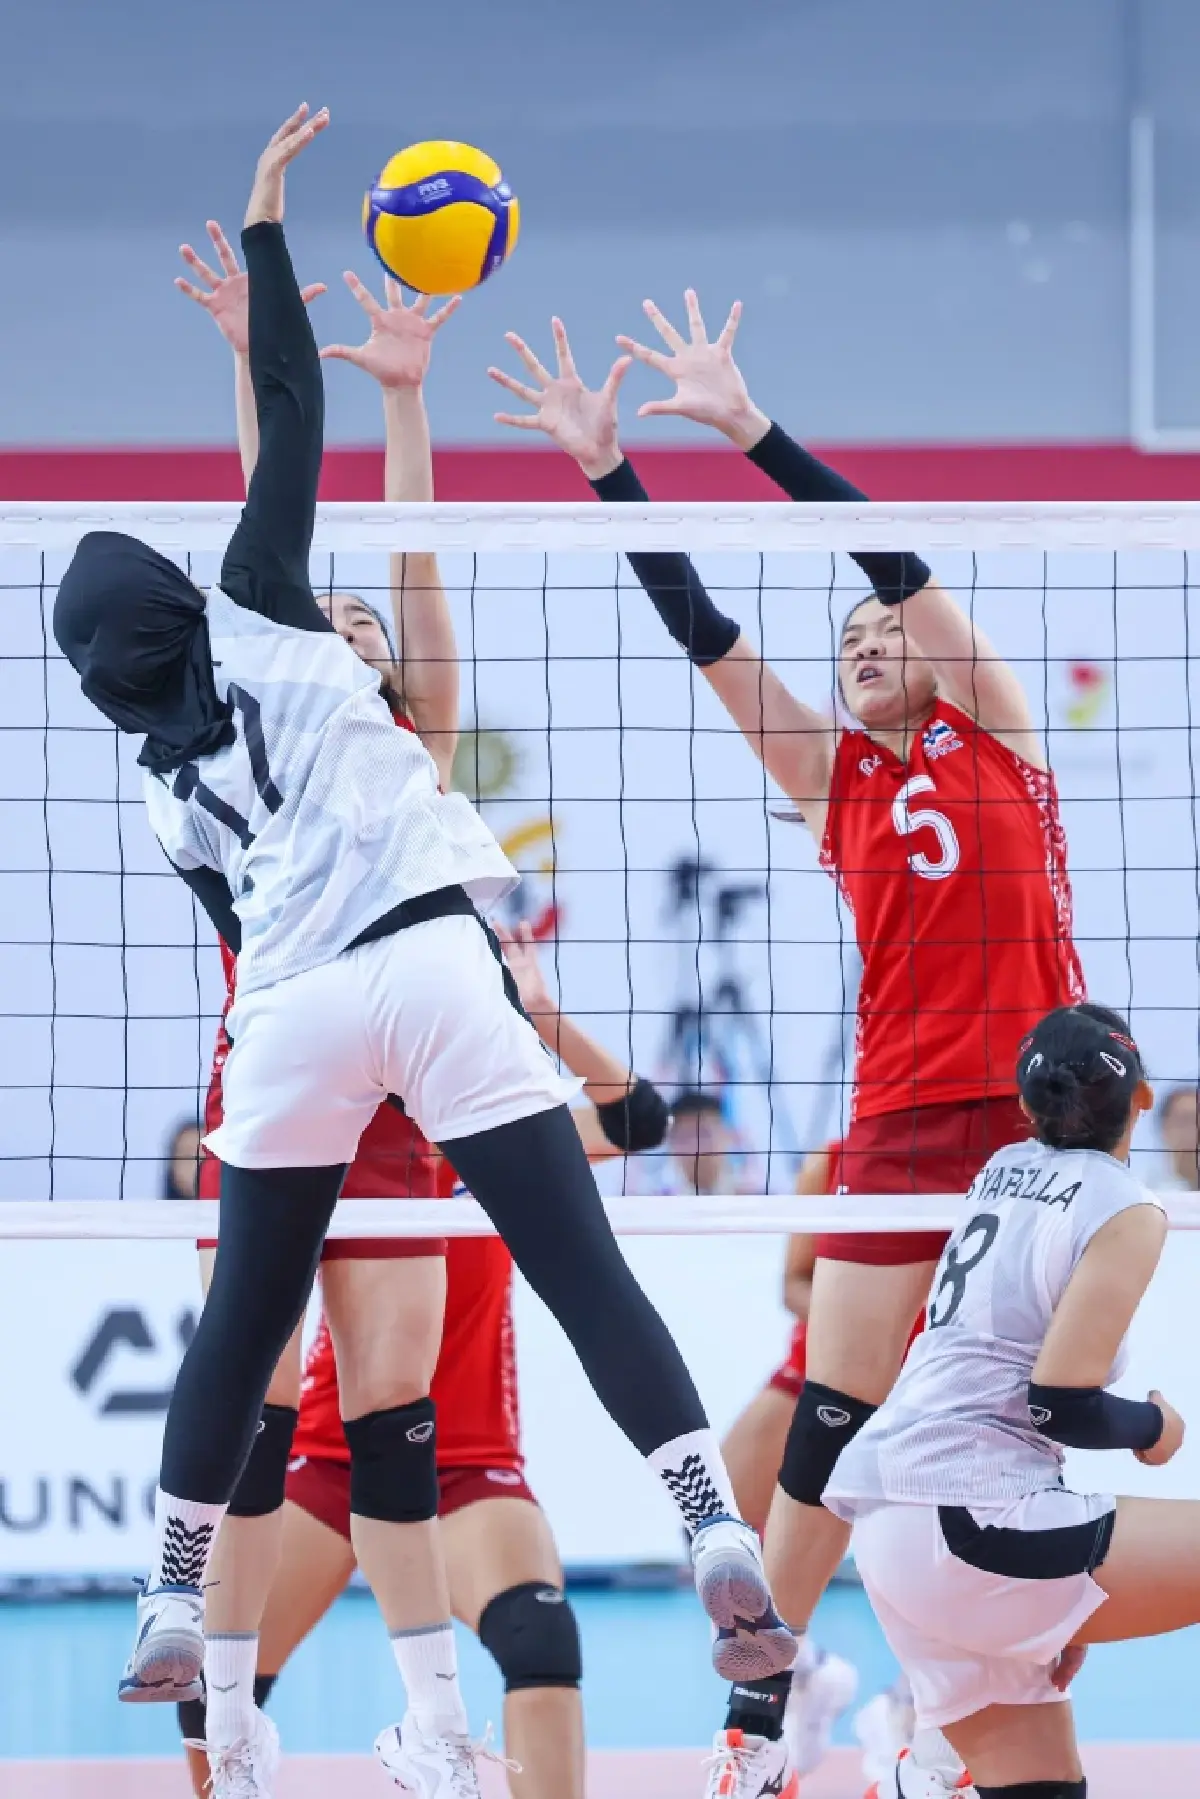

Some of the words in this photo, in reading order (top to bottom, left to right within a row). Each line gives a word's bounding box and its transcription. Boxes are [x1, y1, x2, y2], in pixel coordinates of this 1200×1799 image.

[891, 774, 960, 880] 5
[929, 1214, 999, 1330] 8
[0, 1476, 158, 1531] UN
